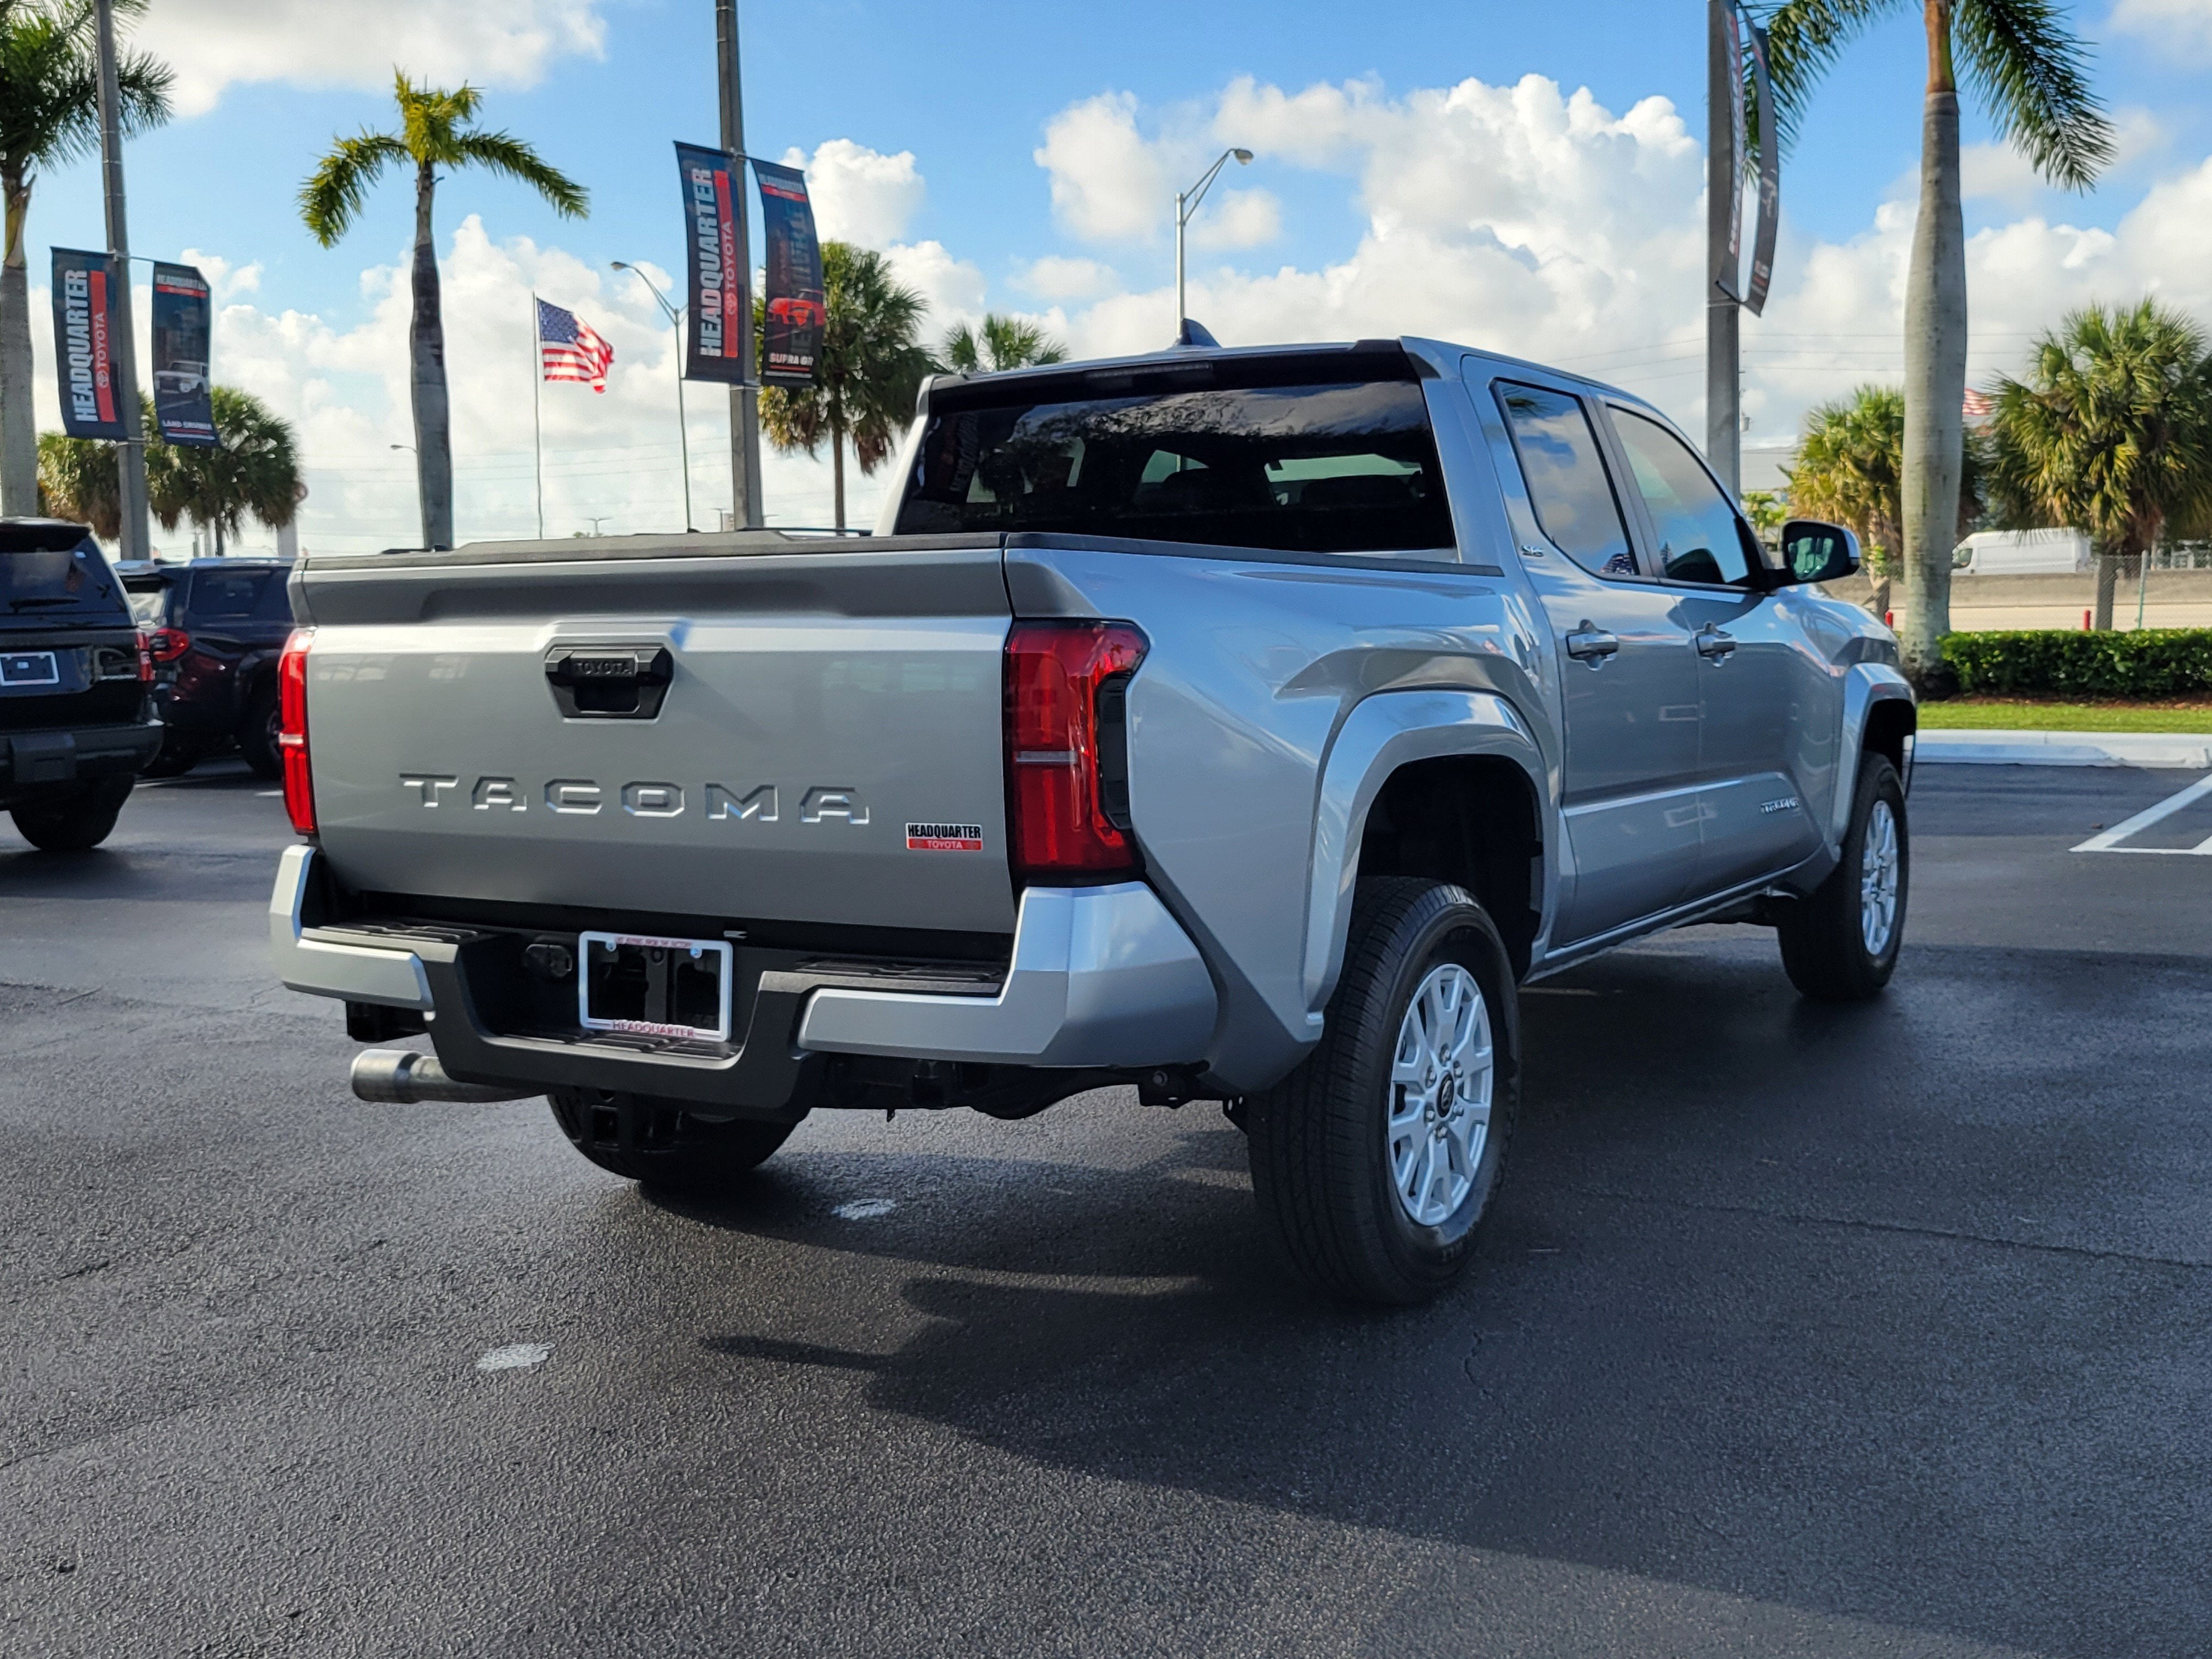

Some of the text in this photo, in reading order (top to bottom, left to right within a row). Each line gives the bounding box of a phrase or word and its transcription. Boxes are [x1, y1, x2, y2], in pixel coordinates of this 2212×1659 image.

[692, 168, 724, 357] HEADQUARTER
[721, 221, 735, 291] TOYOTA
[65, 269, 97, 422] HEADQUARTER
[94, 312, 106, 367] TOYOTA
[769, 352, 799, 365] SUPRA
[575, 662, 633, 675] TOYOTA
[399, 773, 870, 825] TACOMA
[907, 825, 981, 838] HEADQUARTER
[927, 840, 963, 849] TOYOTA
[612, 1019, 694, 1038] HEADQUARTER
